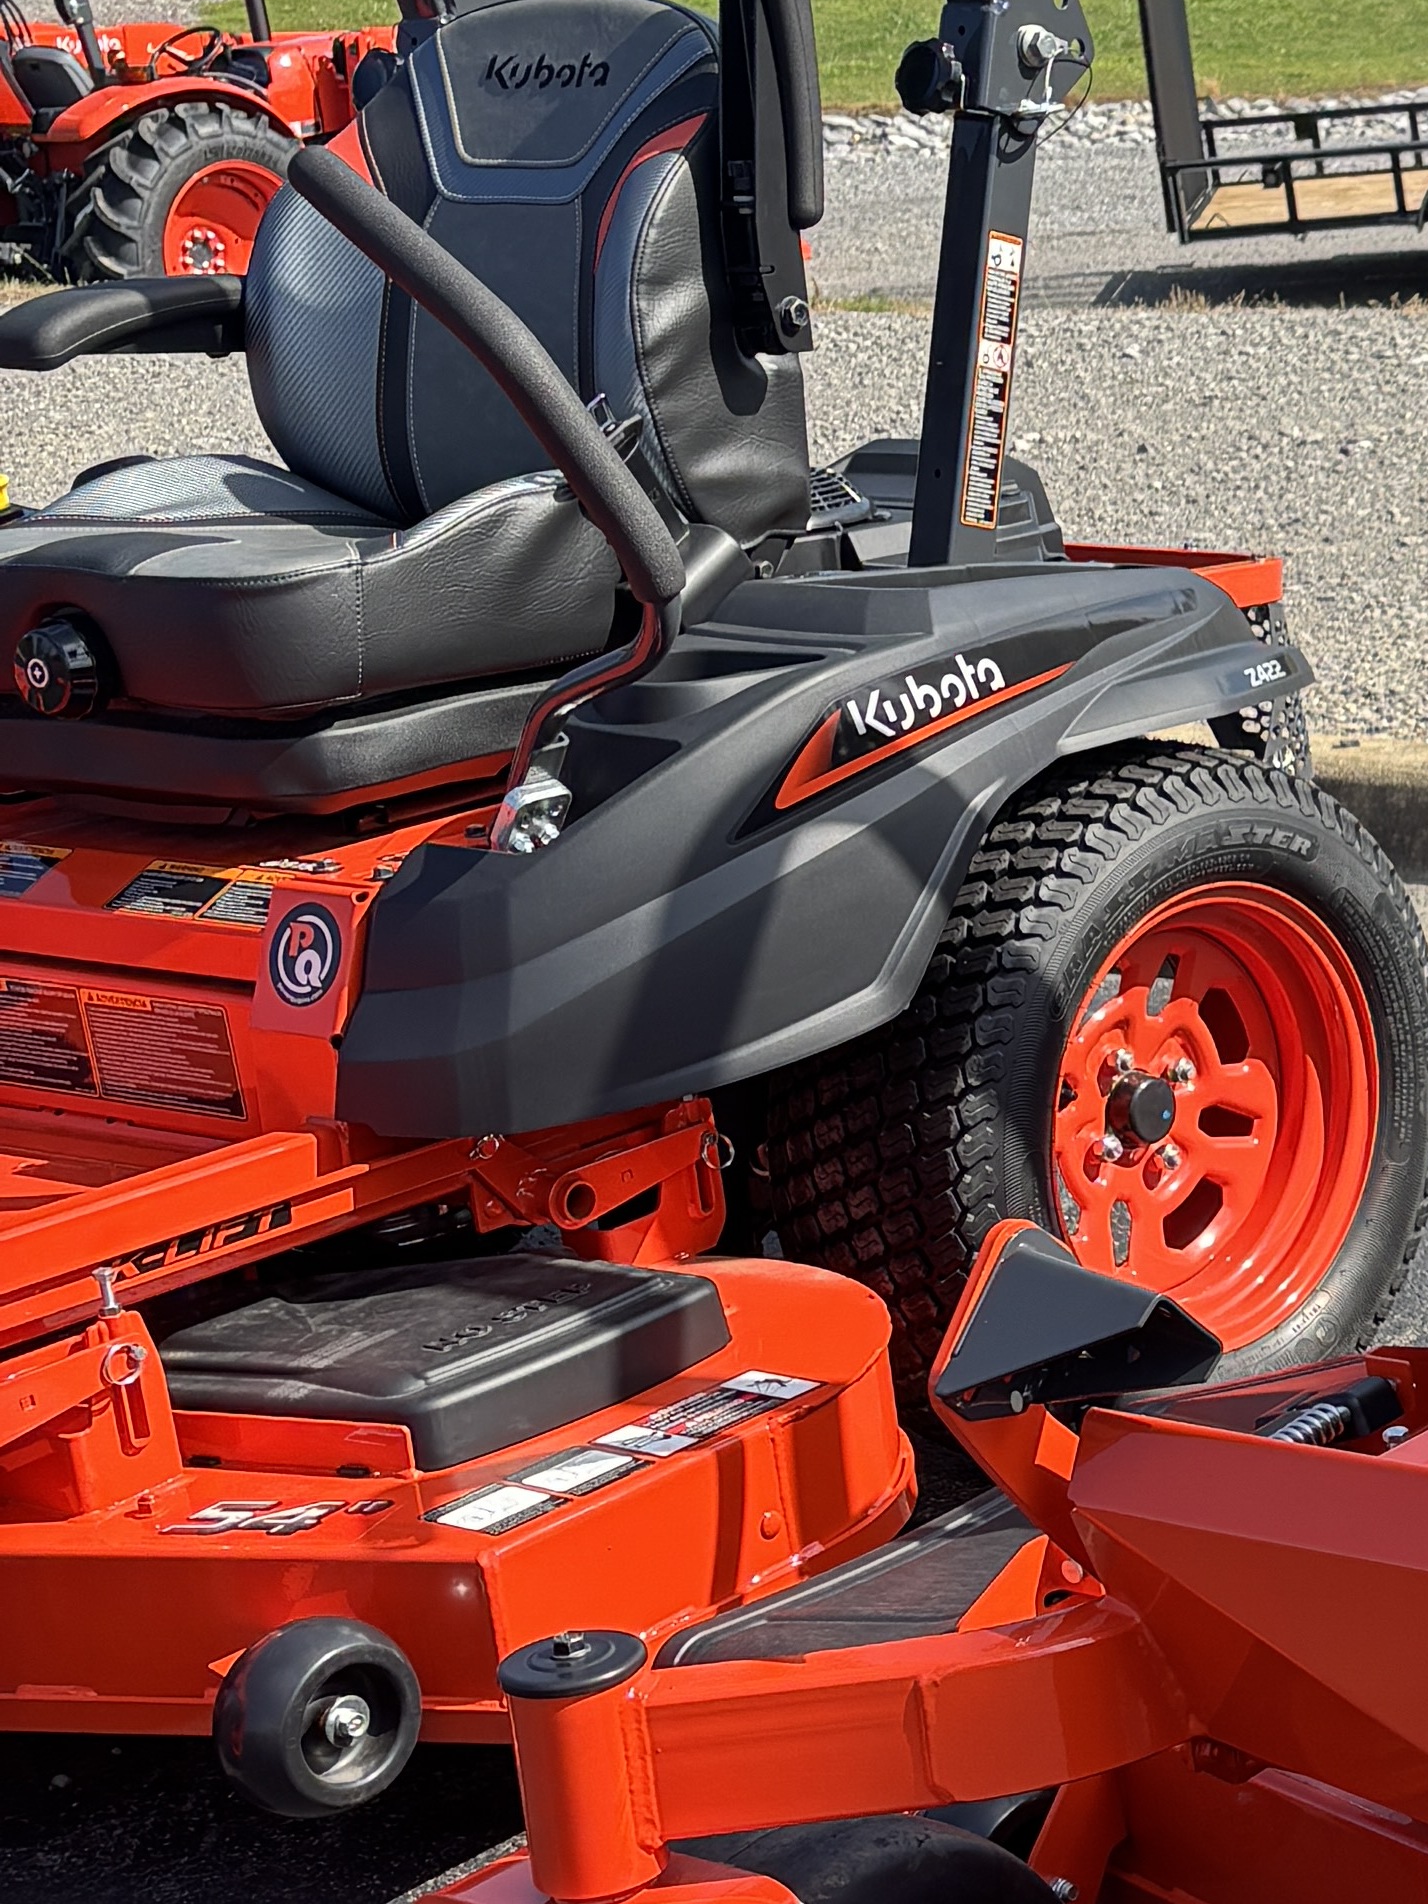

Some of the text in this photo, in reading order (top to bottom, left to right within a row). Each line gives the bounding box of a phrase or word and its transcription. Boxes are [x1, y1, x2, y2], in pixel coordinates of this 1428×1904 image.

[484, 52, 610, 90] Kubota
[1243, 659, 1287, 688] Z422
[846, 653, 1006, 737] Kubota
[422, 1324, 493, 1354] NO
